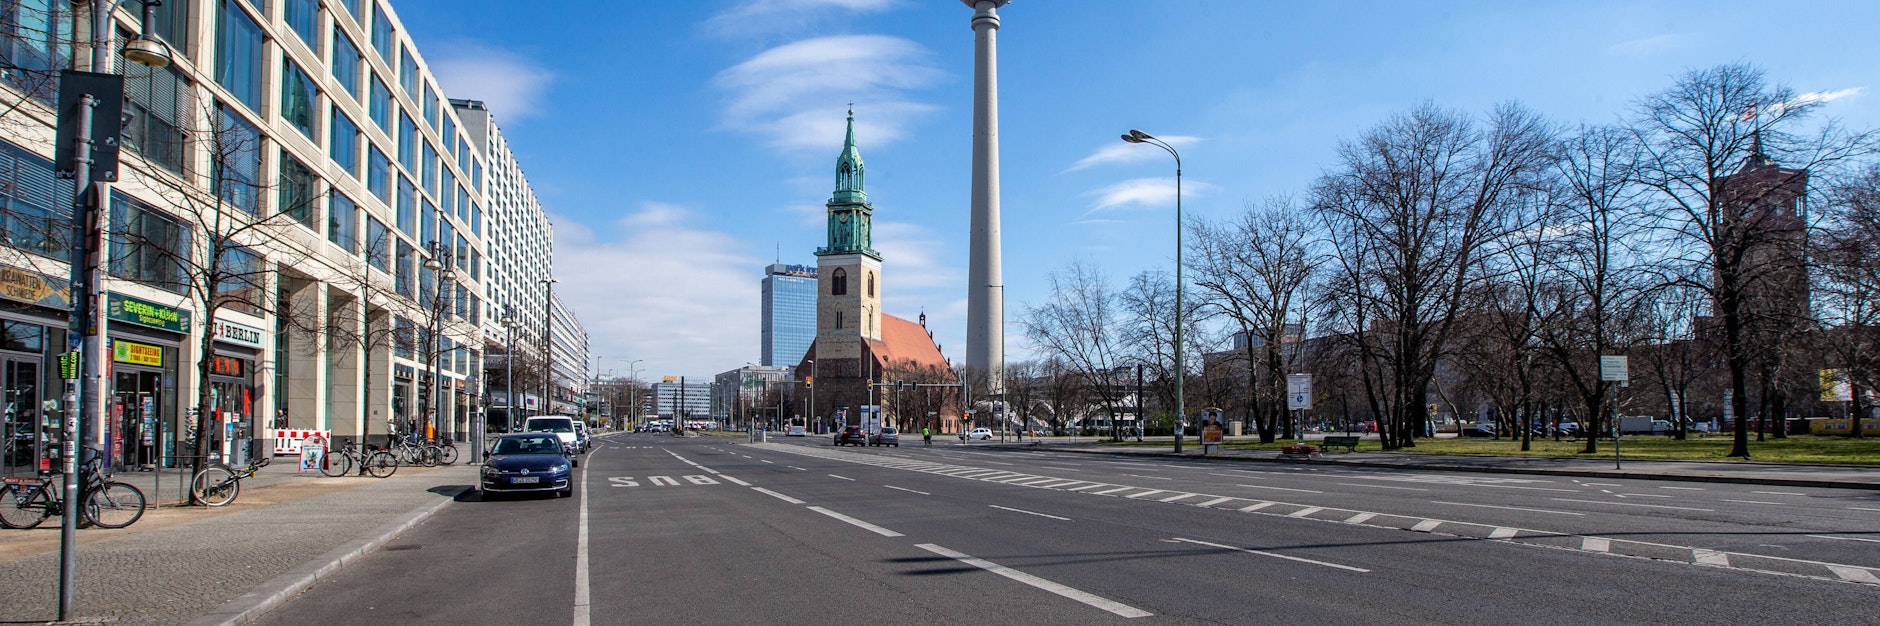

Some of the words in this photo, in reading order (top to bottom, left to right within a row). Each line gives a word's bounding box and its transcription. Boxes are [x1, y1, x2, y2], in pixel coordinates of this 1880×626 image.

[225, 324, 260, 344] BERLIN
[130, 344, 160, 357] SIGHTSEEING
[607, 475, 721, 487] BUS
